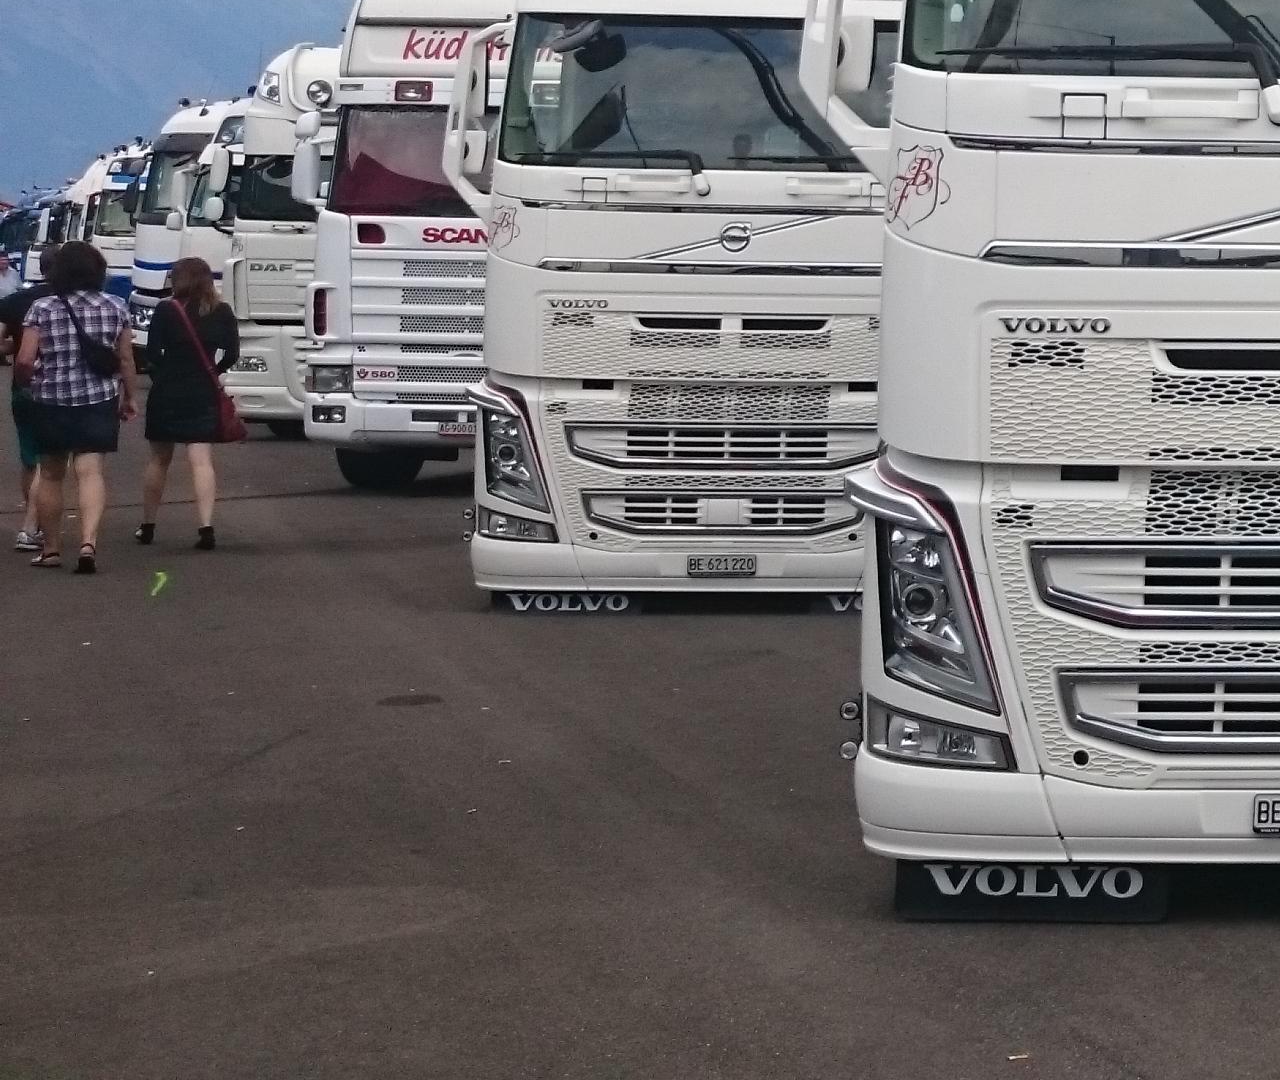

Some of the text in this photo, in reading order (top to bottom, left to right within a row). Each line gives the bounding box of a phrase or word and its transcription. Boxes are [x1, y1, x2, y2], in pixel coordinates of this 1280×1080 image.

[422, 227, 488, 244] SCAN
[249, 263, 293, 272] DAF
[547, 299, 609, 309] VOLVO
[998, 317, 1112, 334] VOLVO
[371, 370, 396, 379] 580
[506, 593, 629, 611] VOLVO
[923, 864, 1144, 899] VOLVO
